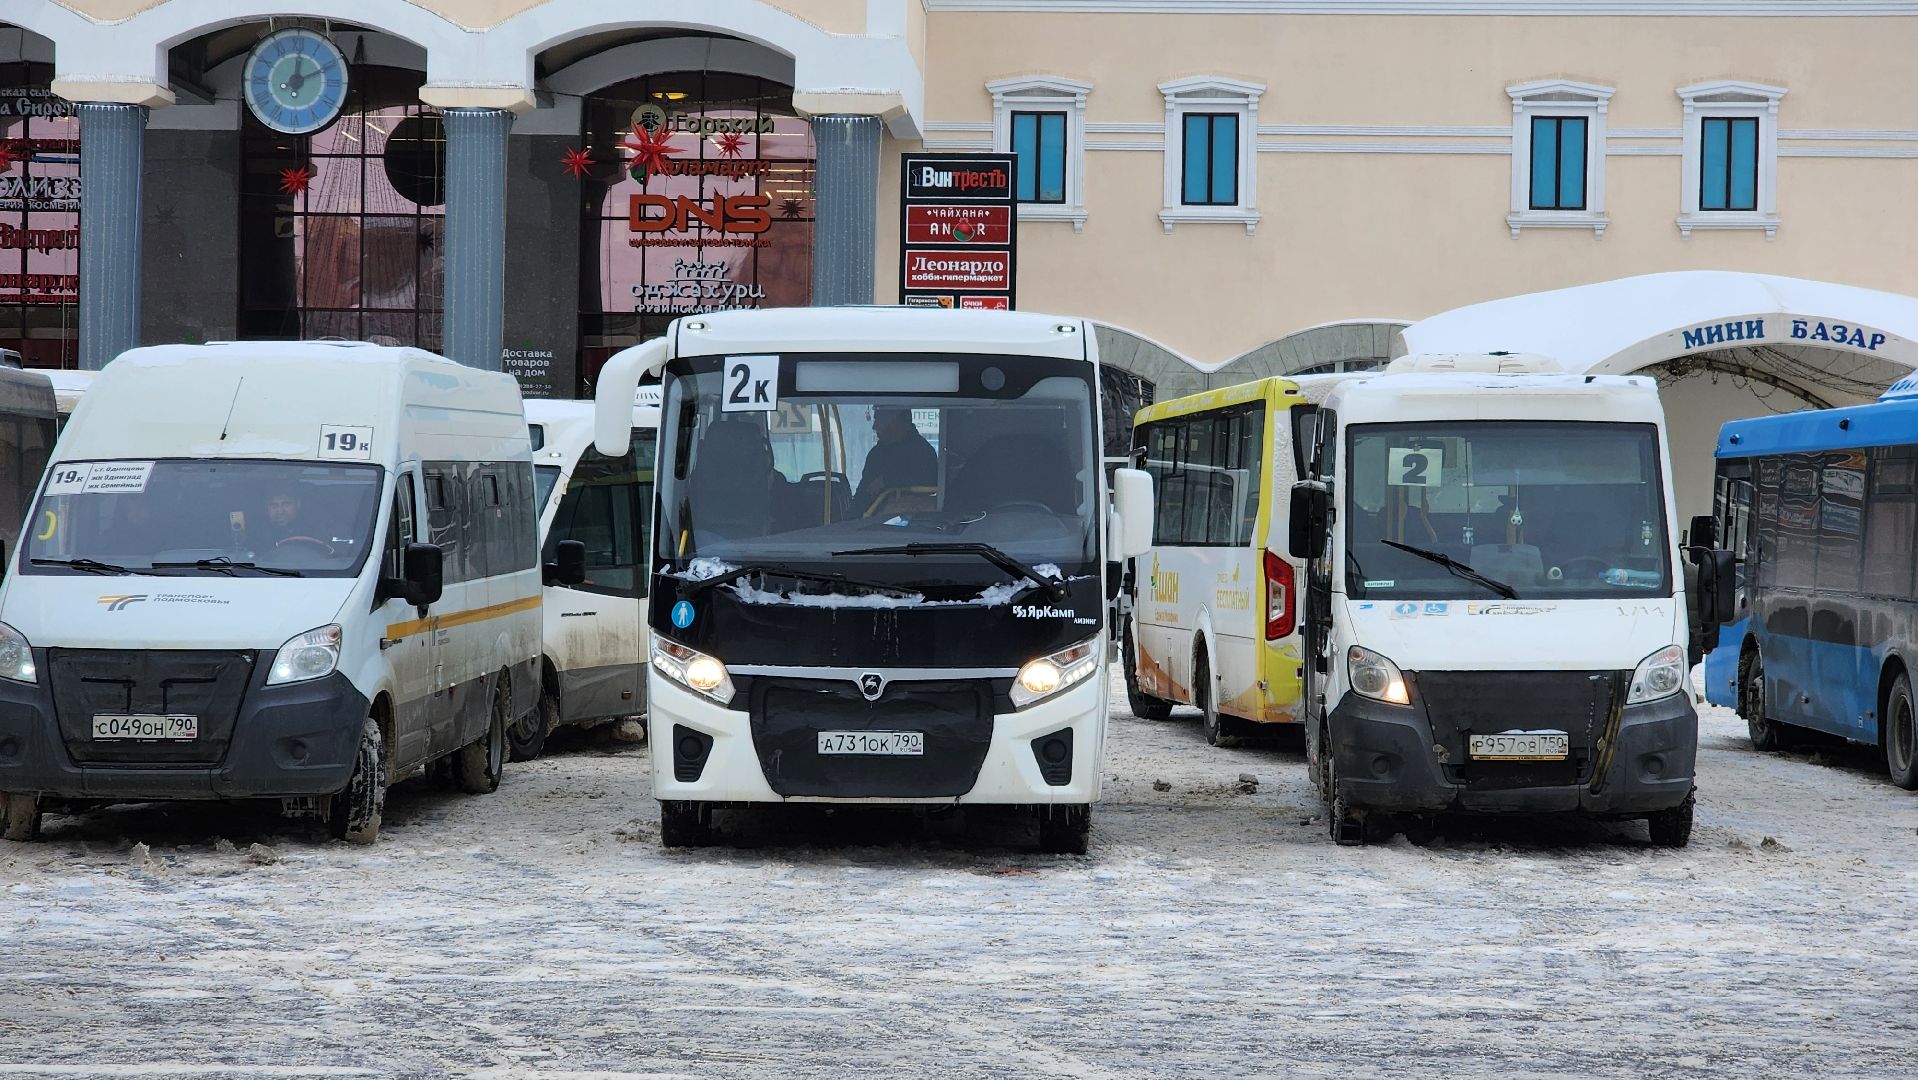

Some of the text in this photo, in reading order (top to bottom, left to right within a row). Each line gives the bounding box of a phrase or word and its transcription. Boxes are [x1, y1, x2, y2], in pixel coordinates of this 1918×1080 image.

[671, 111, 774, 139] Горький
[650, 156, 771, 183] аламарт
[629, 194, 772, 233] DNS
[933, 208, 984, 218] ЧАЙХАНА
[911, 257, 1004, 274] Леонардо
[1682, 319, 1886, 350] МИНИ БАЗАР
[503, 349, 553, 358] Доставка
[505, 360, 550, 368] товаров
[524, 369, 546, 377] дом
[1402, 454, 1428, 484] 2
[1028, 605, 1075, 619] ЯрКамп
[98, 718, 193, 736] С049ОН 790
[824, 734, 919, 752] А731ОК 790
[1540, 737, 1564, 748] 750
